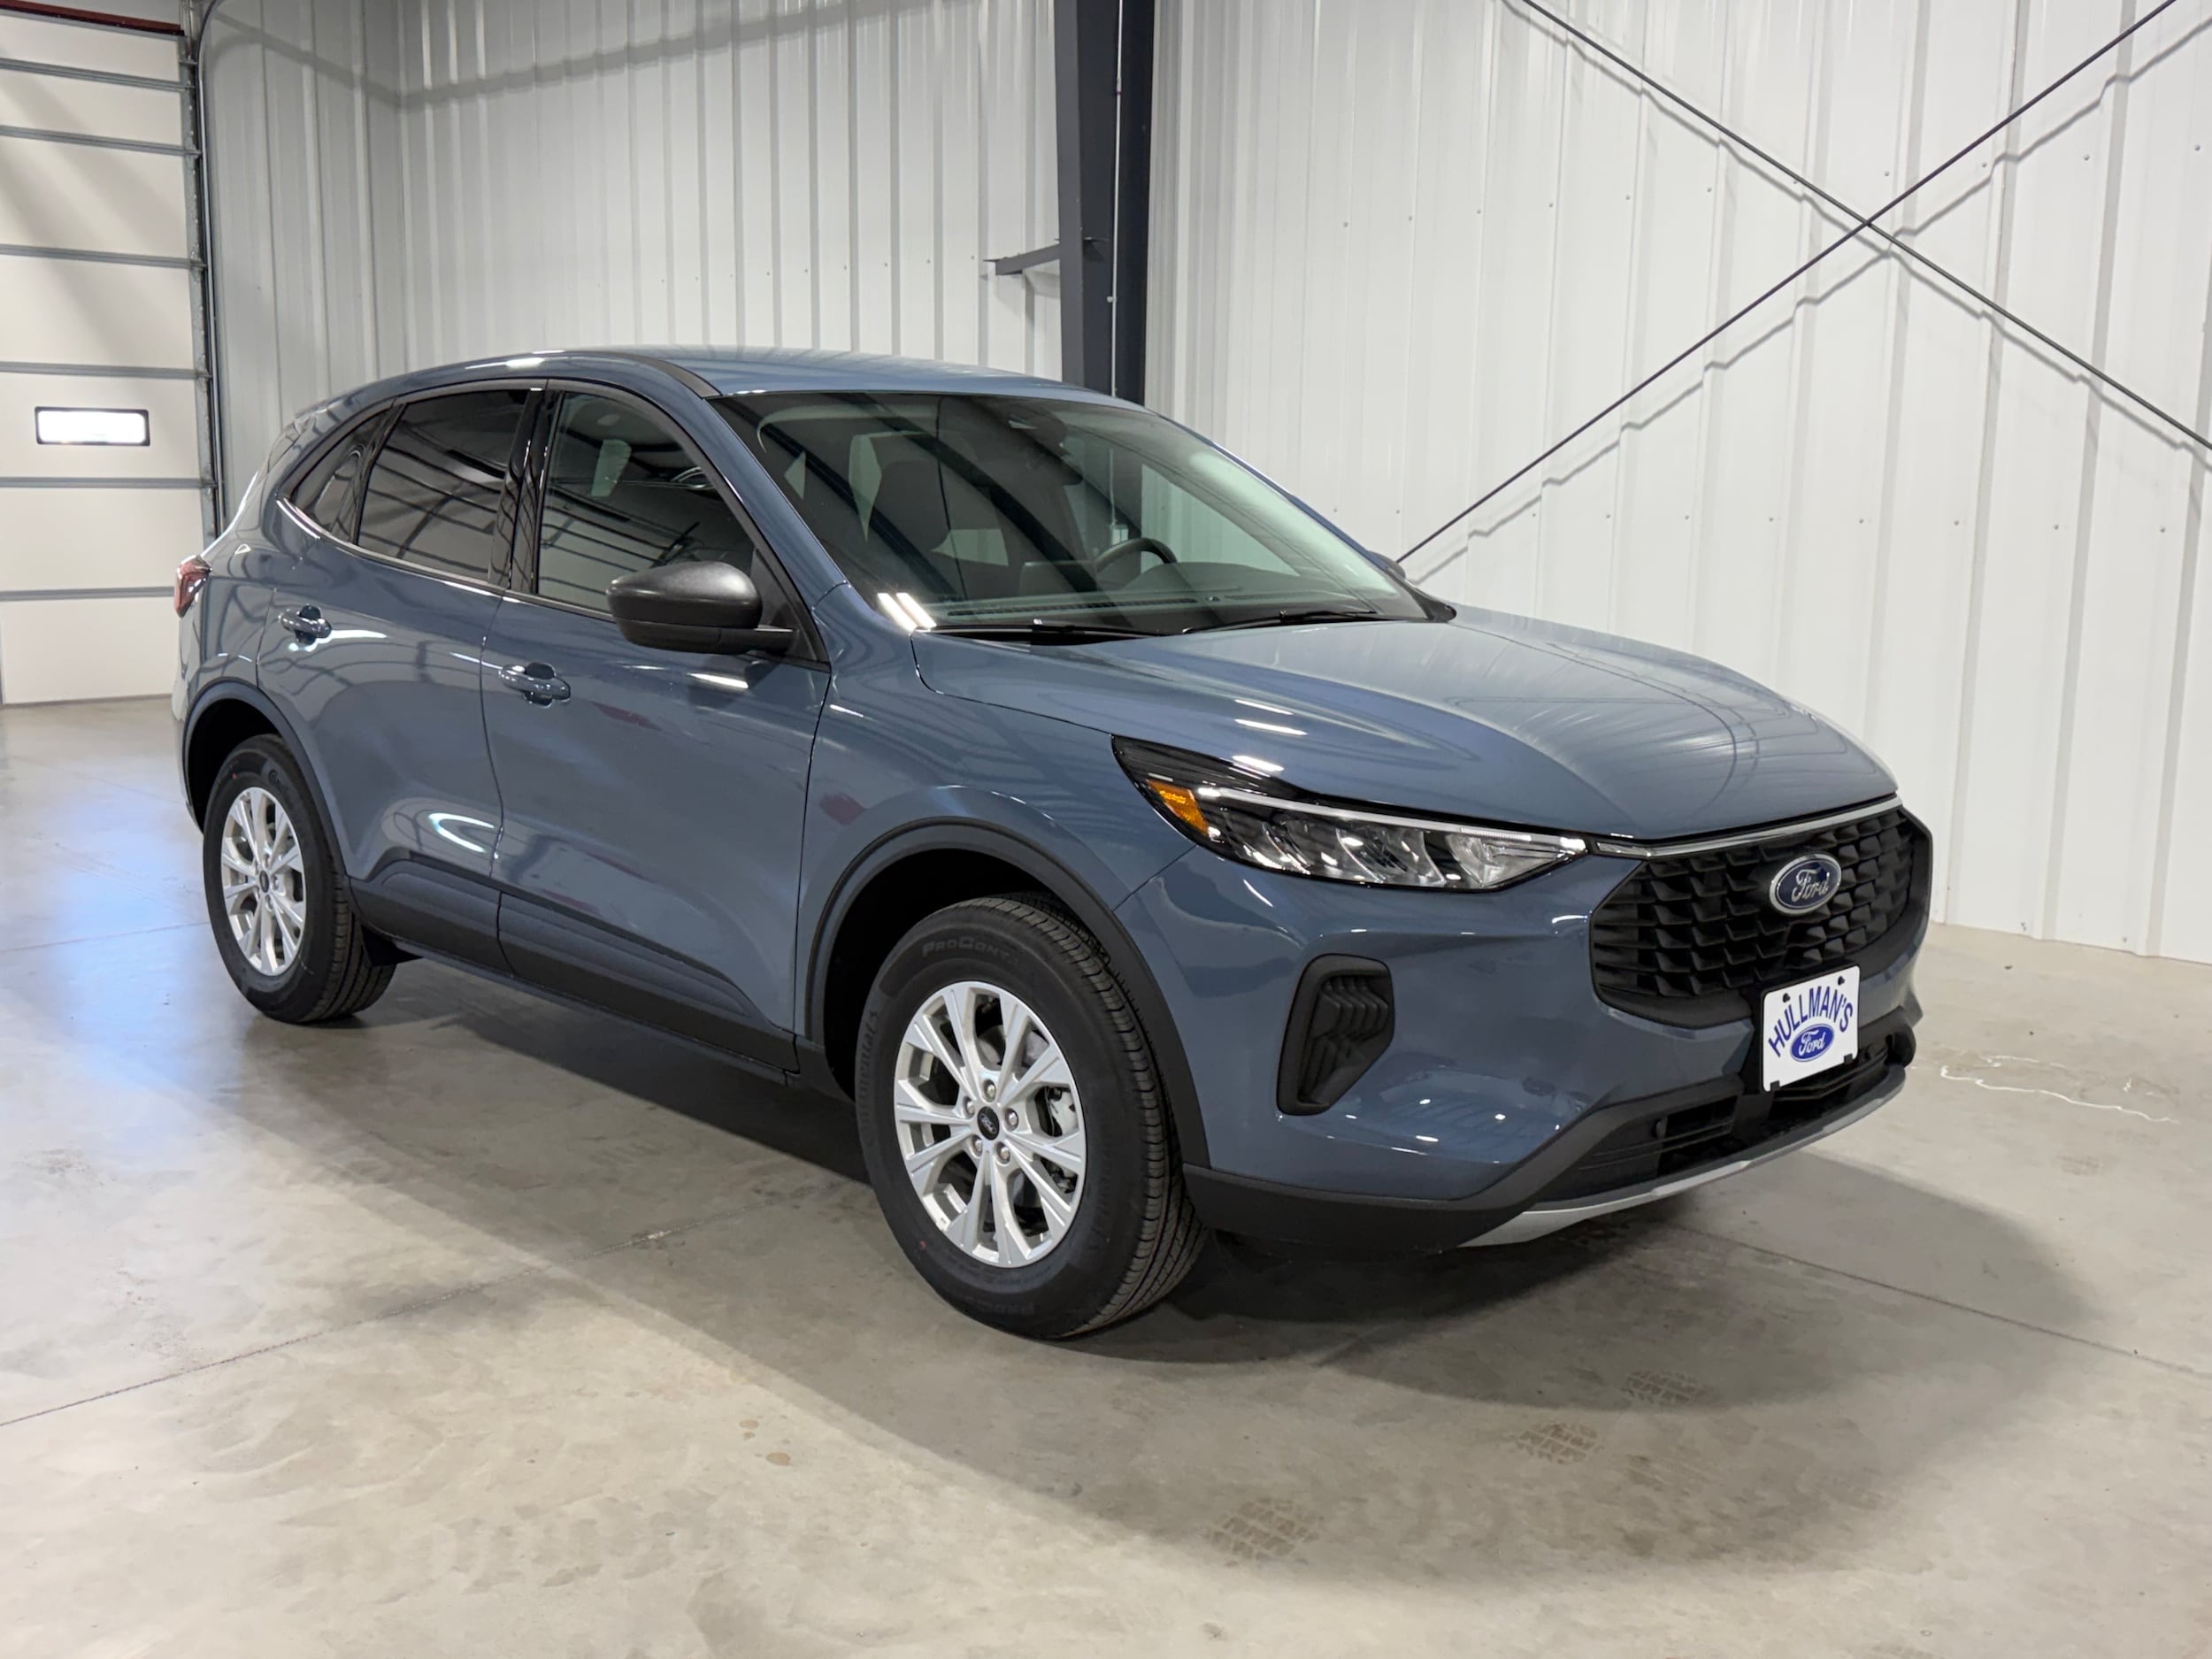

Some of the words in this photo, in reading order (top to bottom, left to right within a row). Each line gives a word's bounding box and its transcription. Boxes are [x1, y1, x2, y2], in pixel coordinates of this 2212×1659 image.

[1791, 867, 1831, 902] Ford
[1768, 985, 1854, 1057] HULLMAN'S
[1798, 1029, 1826, 1056] Ford
